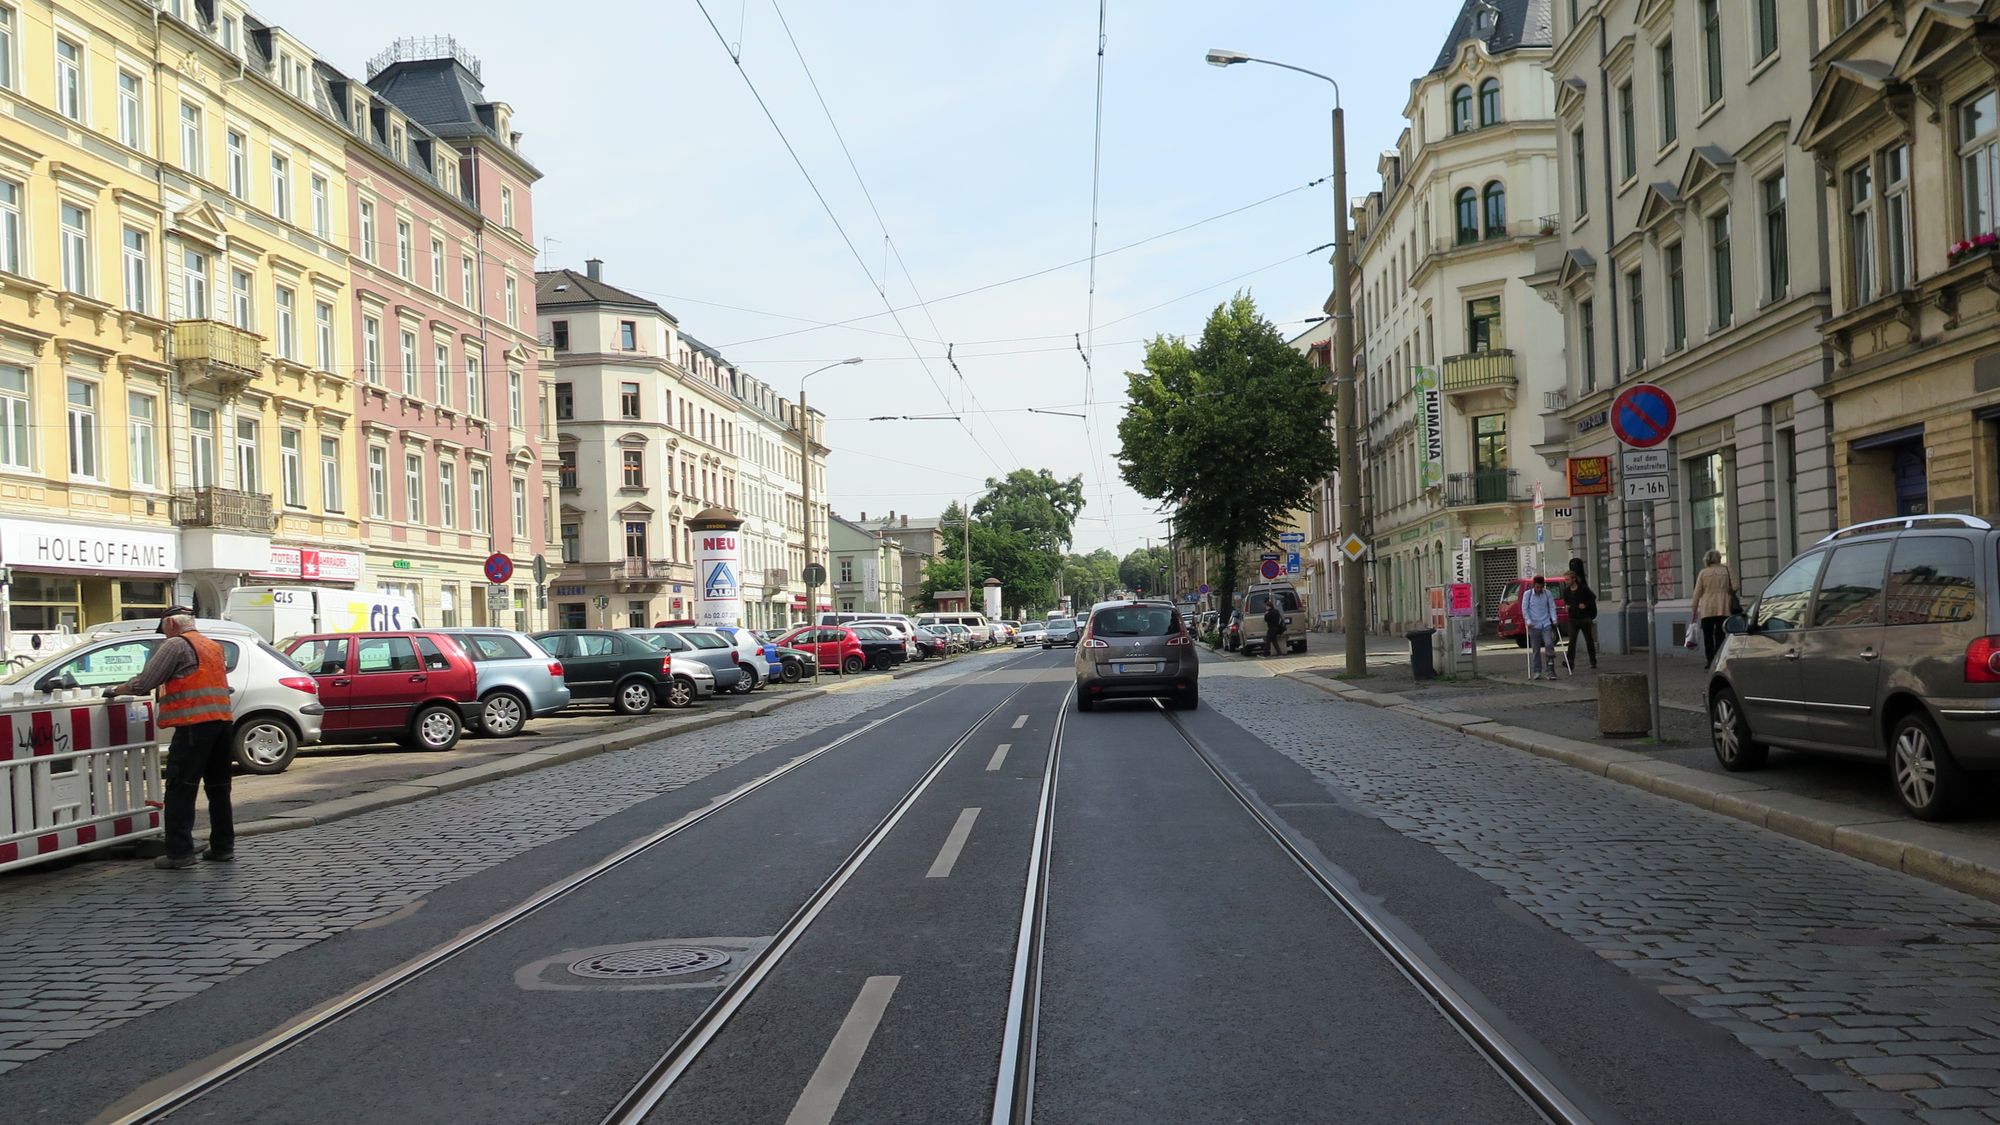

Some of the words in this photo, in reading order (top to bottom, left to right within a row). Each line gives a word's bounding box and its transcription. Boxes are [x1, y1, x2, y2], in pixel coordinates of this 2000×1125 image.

[1425, 390, 1441, 460] HUMANA
[1645, 454, 1657, 462] dem
[1625, 463, 1666, 472] Seitenstreifen
[1630, 483, 1635, 495] 7
[703, 537, 735, 551] NEU
[38, 536, 87, 563] HOLE
[94, 541, 116, 565] OF
[121, 543, 166, 568] FAME
[1288, 554, 1295, 563] P
[1456, 553, 1464, 583] MANA
[274, 591, 294, 604] GLS
[709, 588, 735, 597] ALDI
